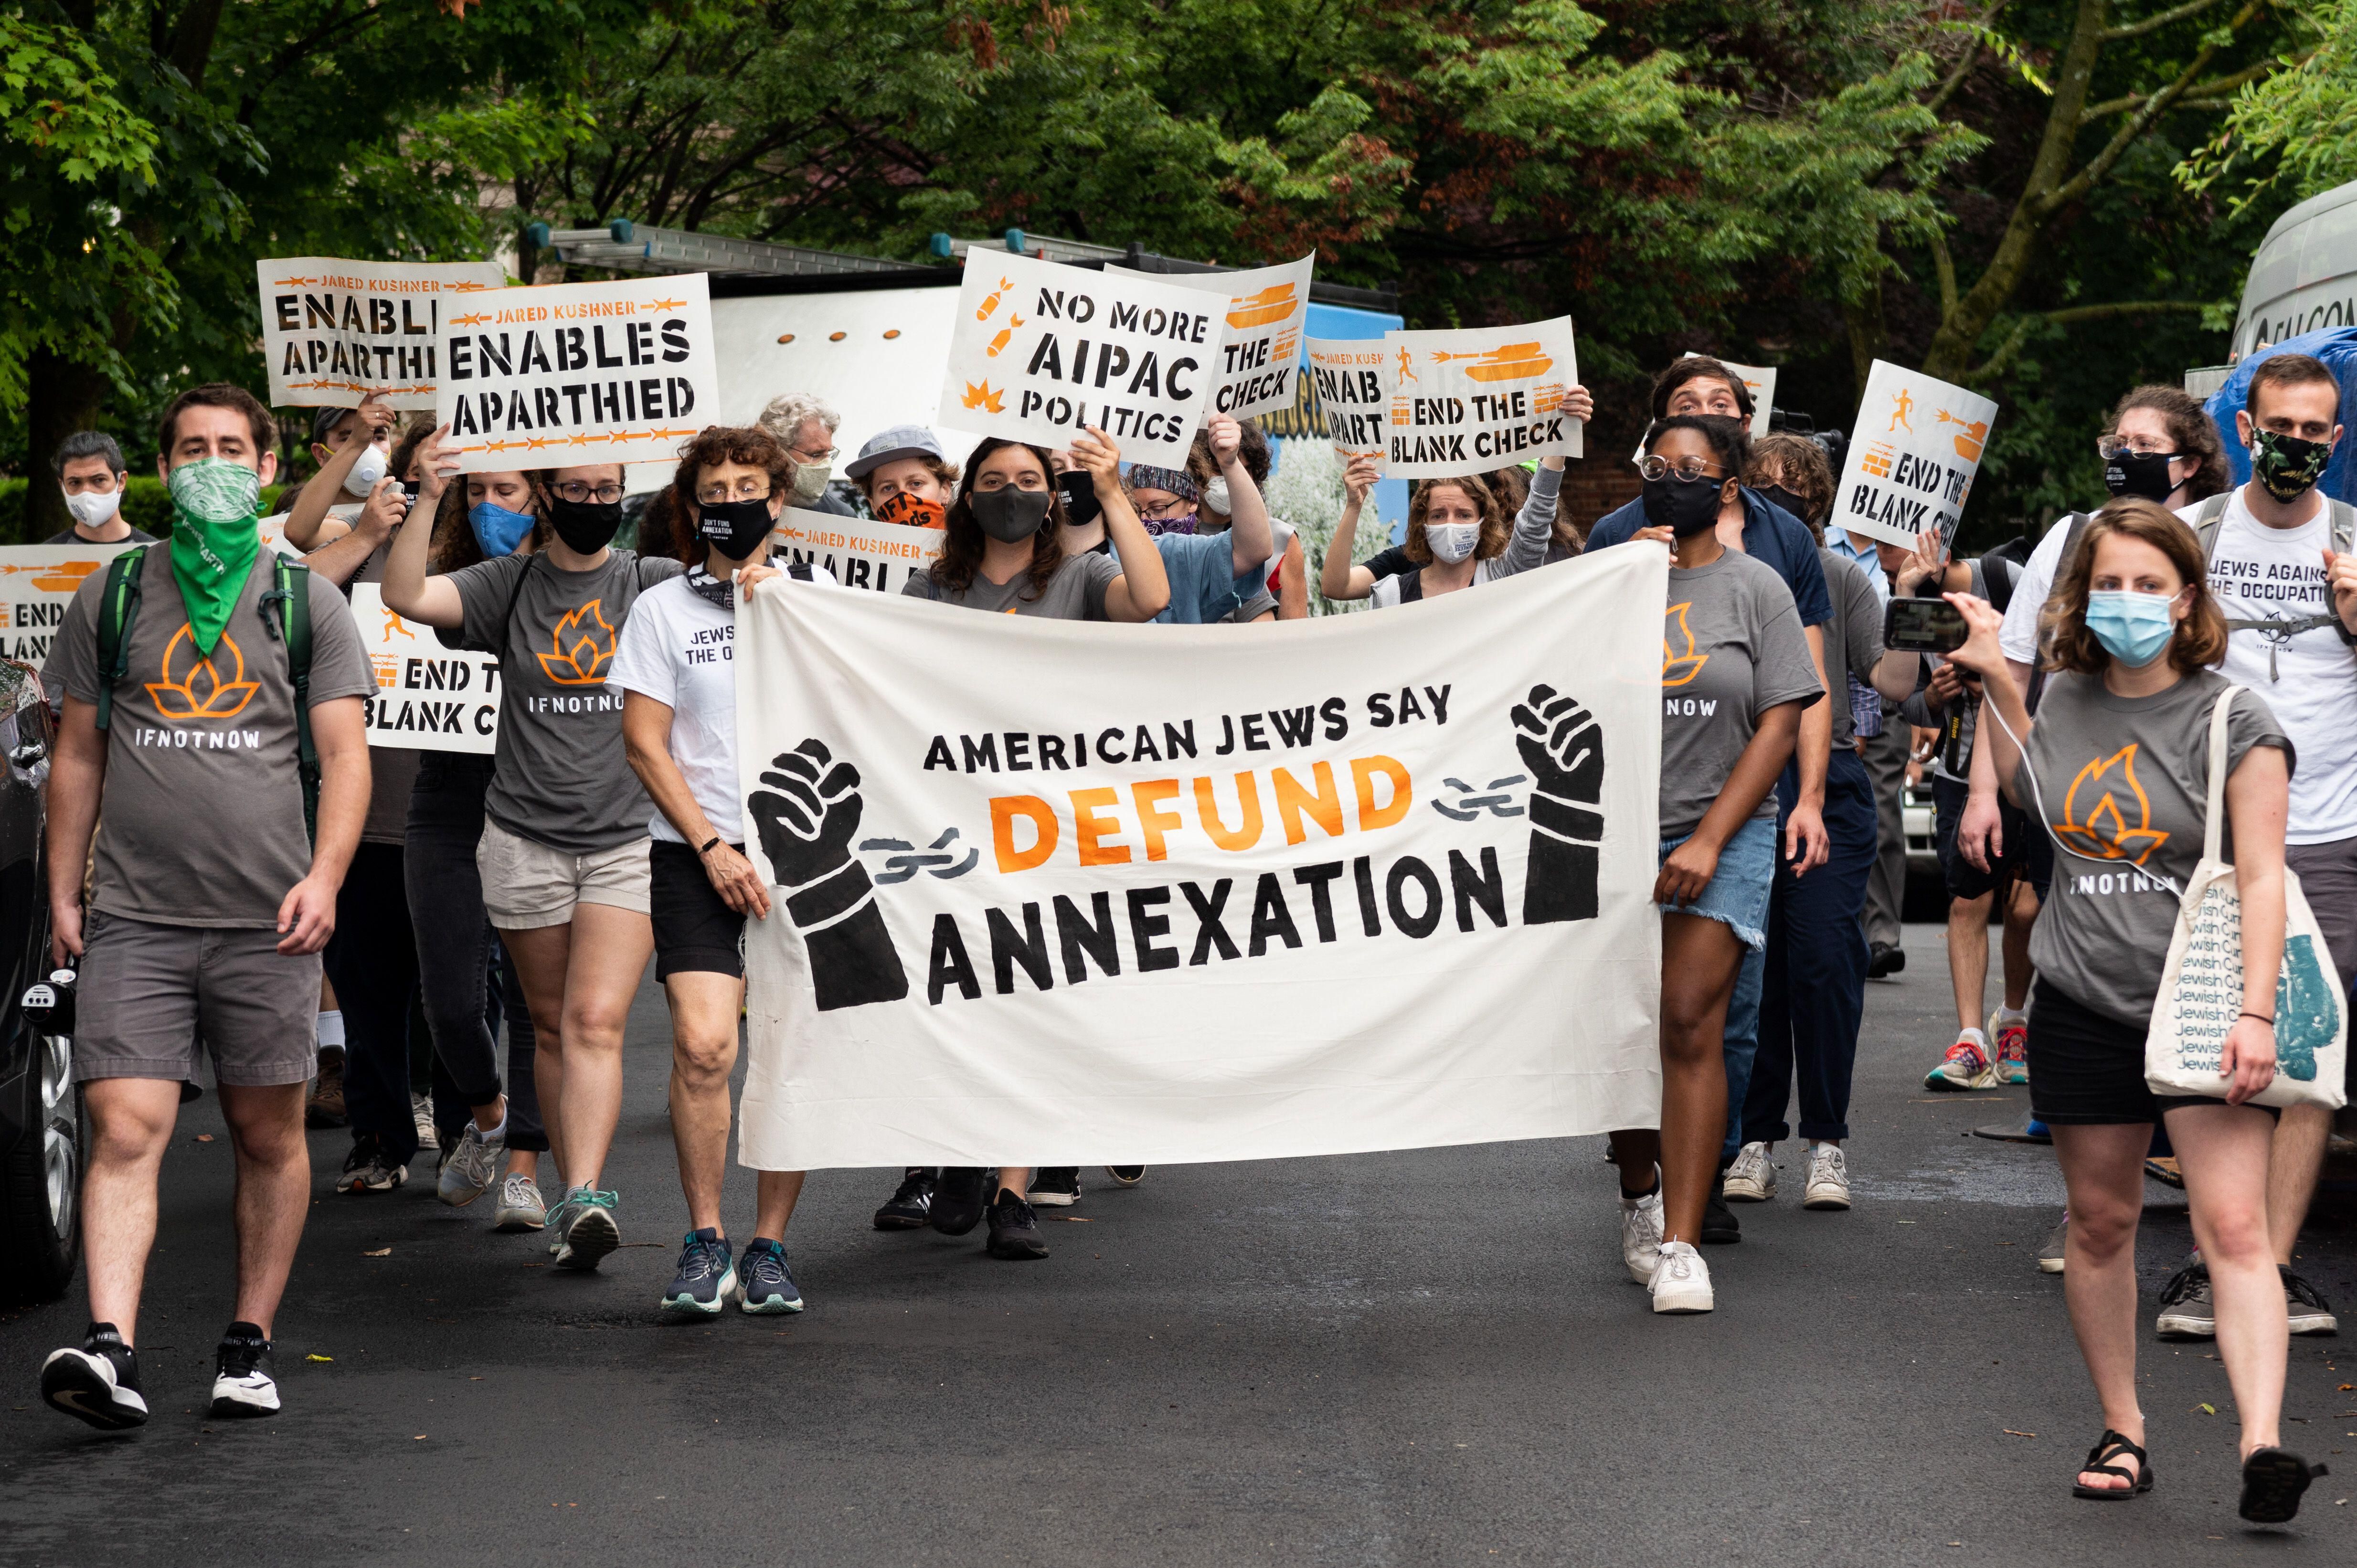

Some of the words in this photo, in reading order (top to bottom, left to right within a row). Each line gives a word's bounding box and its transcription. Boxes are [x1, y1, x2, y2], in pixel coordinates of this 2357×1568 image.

[321, 275, 364, 290] JARED
[369, 279, 440, 292] KUSHNER
[496, 307, 548, 324] JARED
[554, 301, 636, 319] KUSHNER
[1037, 287, 1095, 323] NO
[1109, 301, 1209, 344] MORE
[449, 318, 690, 381] ENABLES
[1224, 338, 1270, 374] THE
[1327, 353, 1353, 364] JARED
[1026, 333, 1199, 401] AIPAC
[1216, 367, 1290, 413] CHECK
[1314, 366, 1383, 403] ENAB
[452, 376, 695, 436] APARTHIED
[1020, 390, 1184, 443] POLITICS
[1414, 398, 1464, 425] END
[1471, 391, 1526, 422] THE
[1327, 409, 1386, 445] APART
[1391, 434, 1467, 463] BLANK
[1475, 417, 1564, 458] CHECK
[1894, 452, 1941, 493] END
[1943, 467, 1966, 505] THE
[1850, 484, 1930, 535] BLANK
[702, 526, 733, 534] ANNEXATION
[806, 529, 845, 548] JARED
[849, 536, 921, 559] KUSHNER
[2209, 560, 2259, 578] JEWS
[16, 603, 65, 627] END
[690, 625, 734, 645] JEWS
[685, 649, 716, 665] THE
[404, 658, 470, 691] END
[364, 699, 466, 734] BLANK
[1667, 699, 1717, 716] NOW
[136, 728, 259, 749] IFNOTNOW
[923, 719, 1198, 773] AMERICAN
[1215, 697, 1348, 756] JEWS
[1367, 684, 1452, 728] SAY
[1951, 717, 1959, 739] Nikon
[988, 754, 1413, 874] DEFUND
[928, 846, 1508, 1006] ANNEXATION
[2173, 988, 2225, 1004] Jewish
[2175, 972, 2223, 988] Jewish
[2174, 1006, 2226, 1021] Jewish
[2175, 1023, 2228, 1038] Jewish
